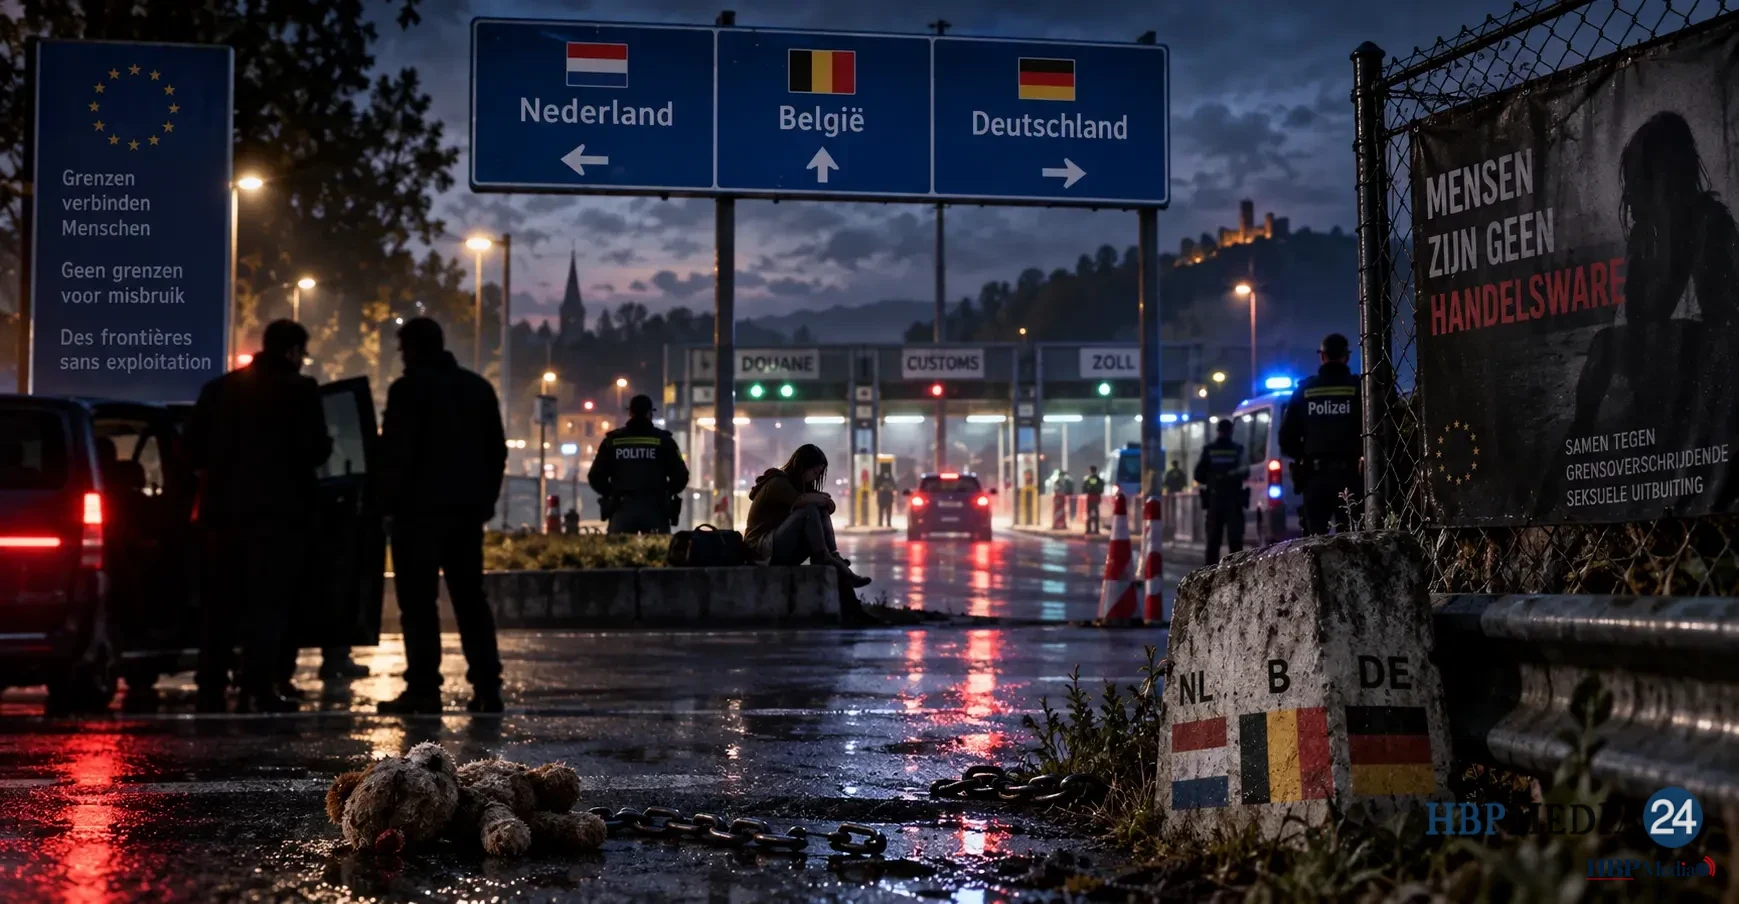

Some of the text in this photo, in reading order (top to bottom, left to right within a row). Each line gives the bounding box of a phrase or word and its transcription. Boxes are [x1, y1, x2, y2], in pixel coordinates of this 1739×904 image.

[519, 96, 674, 127] Nederland
[778, 104, 865, 138] België
[971, 110, 1129, 141] Deutschland
[62, 169, 135, 187] Grenzen
[1426, 147, 1534, 220] MENSEN
[62, 194, 151, 212] verbinden
[61, 219, 151, 237] Menschen
[1428, 207, 1555, 279] ZIJN GEEN
[61, 261, 184, 283] Geen grenzen
[60, 286, 186, 304] voor misbruik
[1430, 256, 1627, 337] HANDELSWARE
[60, 327, 193, 346] Des frontières
[60, 353, 212, 374] sans exploitation
[741, 355, 814, 373] DOUANE
[906, 355, 980, 371] CUSTOMS
[1092, 354, 1136, 371] ZOLL
[1308, 399, 1351, 416] Polizei
[615, 447, 657, 460] POLITIE
[1565, 428, 1656, 456] SAMEN TEGEN
[1566, 443, 1729, 481] GRENSOVERSCHRIJDENDE
[1566, 476, 1704, 507] SEKSUELE UITBUITING
[1268, 659, 1291, 694] B
[1358, 655, 1412, 690] DE
[1179, 670, 1213, 706] NL
